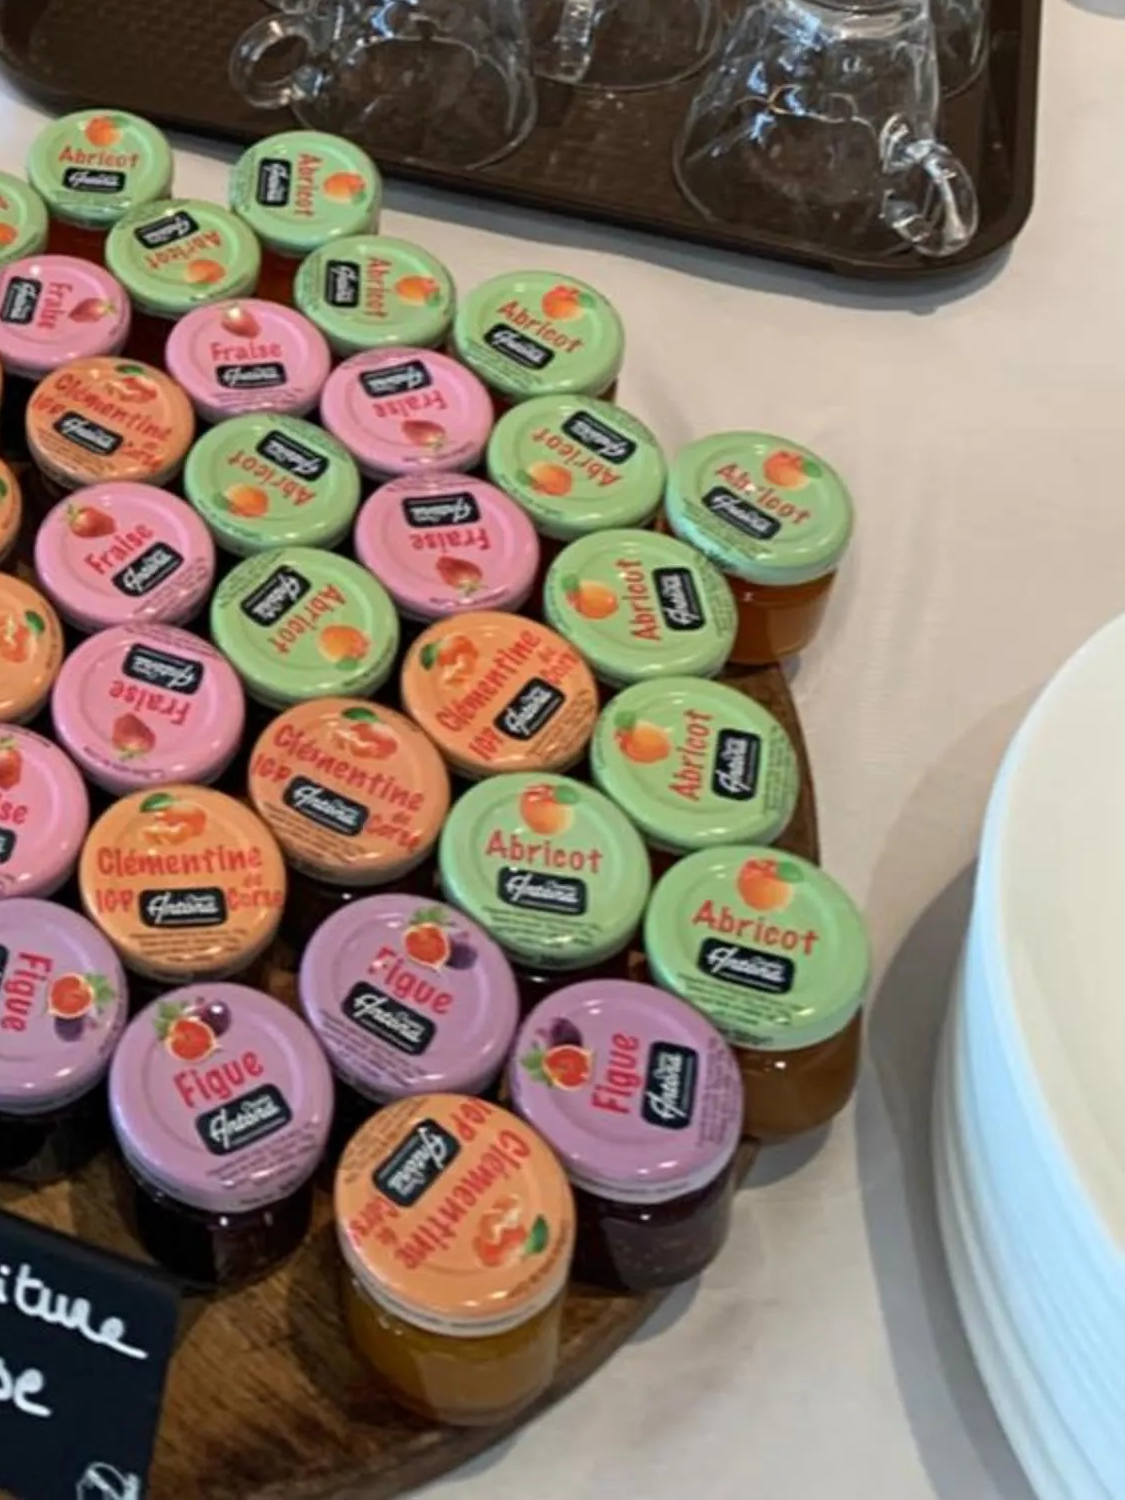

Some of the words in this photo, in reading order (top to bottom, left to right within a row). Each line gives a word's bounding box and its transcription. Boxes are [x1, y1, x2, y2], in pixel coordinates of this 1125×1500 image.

[59, 146, 139, 166] Abricot
[296, 154, 324, 216] Abricot
[364, 260, 393, 318] Abricot
[211, 342, 283, 360] Fraise
[497, 301, 584, 352] Abricot
[373, 391, 447, 418] Fraise
[229, 450, 317, 506] Abricot
[531, 428, 623, 487] Abricot
[716, 464, 811, 524] Abricot
[85, 525, 155, 575] Fraise
[412, 529, 491, 551] Fraise
[269, 583, 347, 654] Abricot
[615, 559, 662, 641] Abricot
[109, 681, 191, 725] Fraise
[669, 710, 714, 802] Abricot
[486, 830, 602, 872] Abricot
[693, 900, 819, 954] Abricot
[1, 953, 53, 1032] Figue
[368, 947, 452, 1015] Figue
[173, 1052, 264, 1108] Figue
[591, 1033, 640, 1113] Figue
